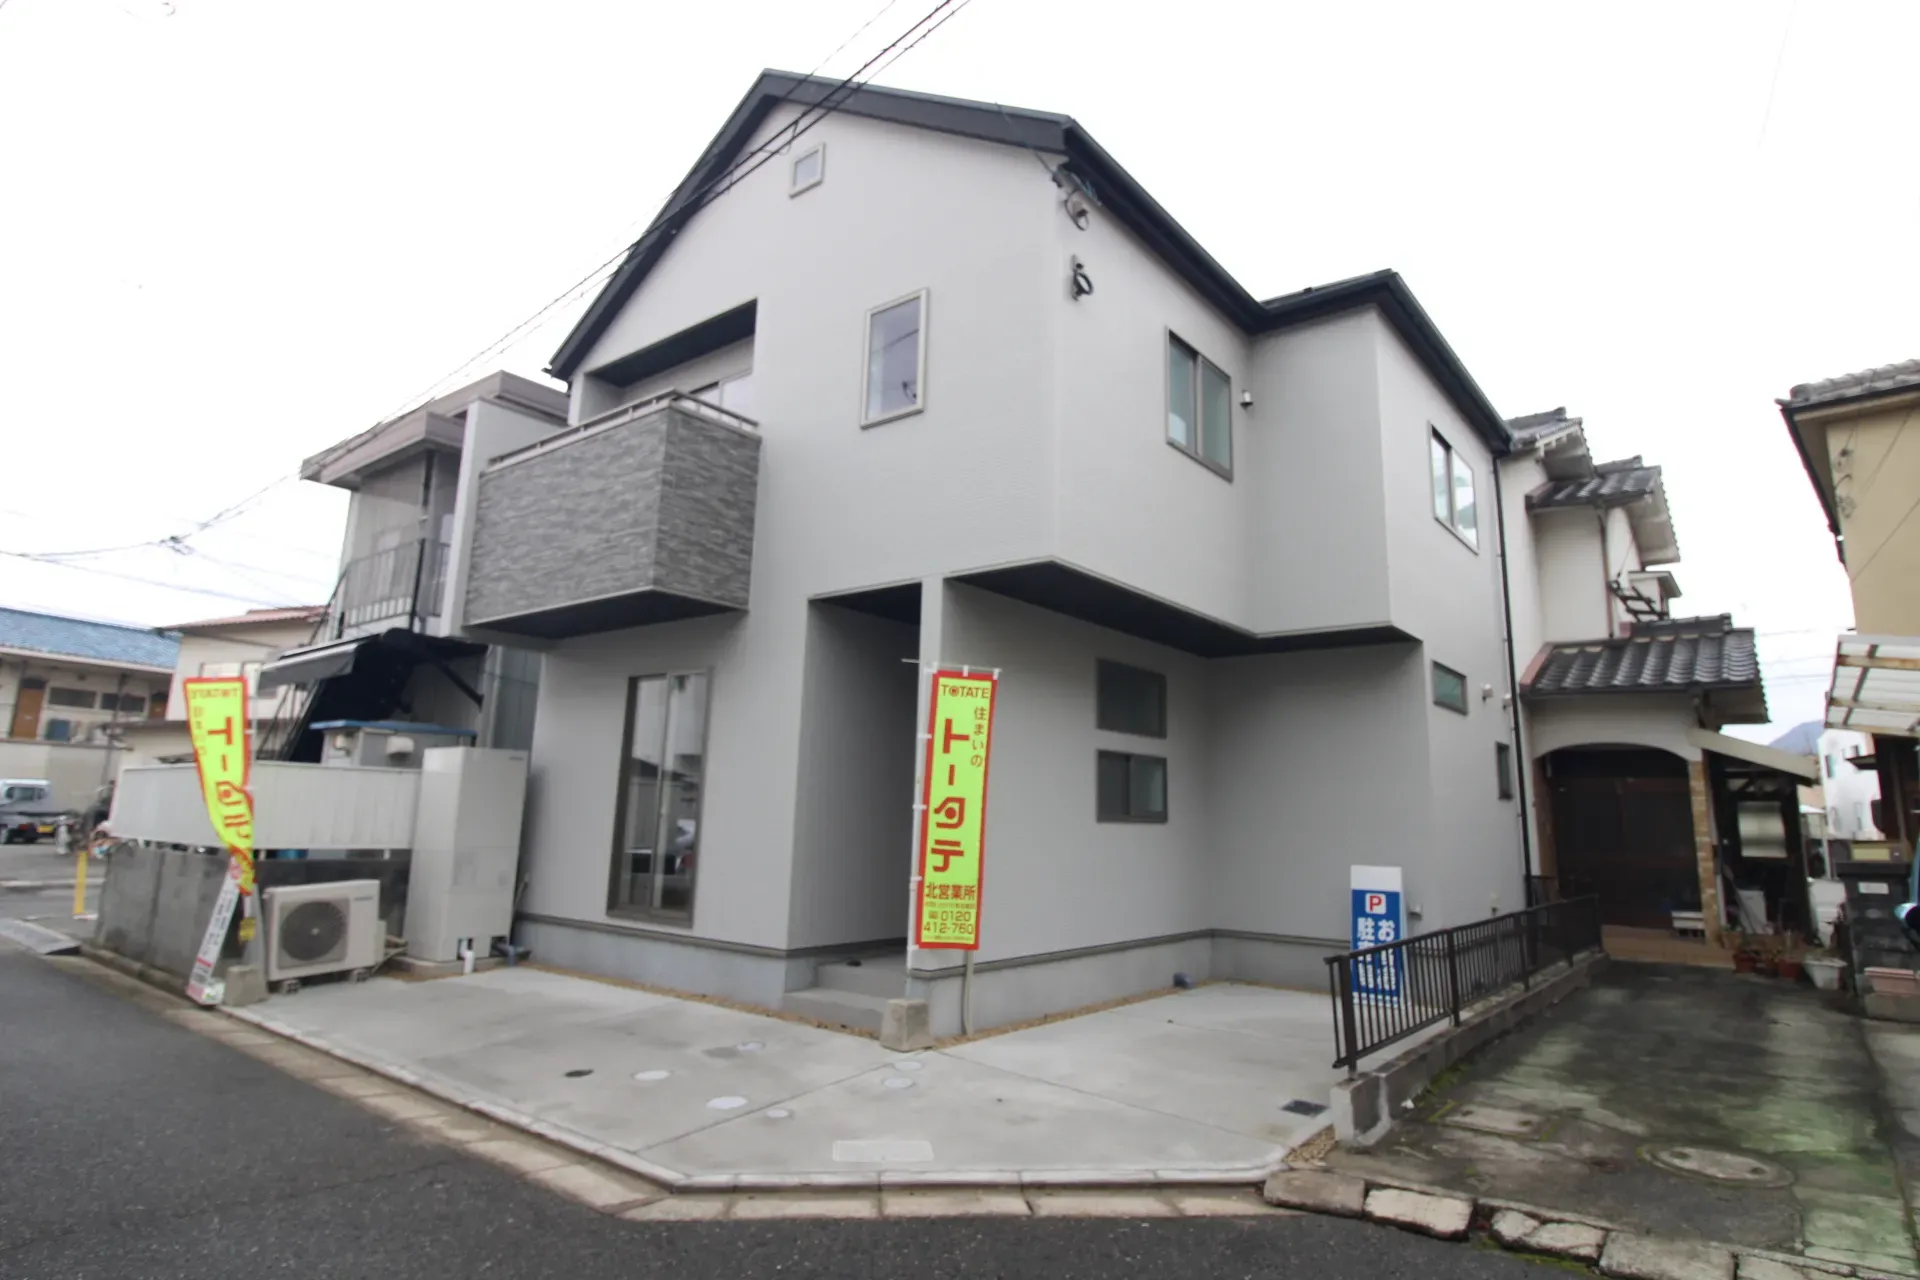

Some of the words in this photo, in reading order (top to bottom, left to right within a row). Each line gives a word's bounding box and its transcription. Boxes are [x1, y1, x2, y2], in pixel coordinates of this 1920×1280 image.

[940, 684, 990, 699] TOTATE
[970, 706, 987, 768] 住まいの
[930, 718, 970, 873] トータテ
[925, 882, 976, 900] 北営業所
[1369, 895, 1382, 912] P
[940, 910, 972, 922] 0120
